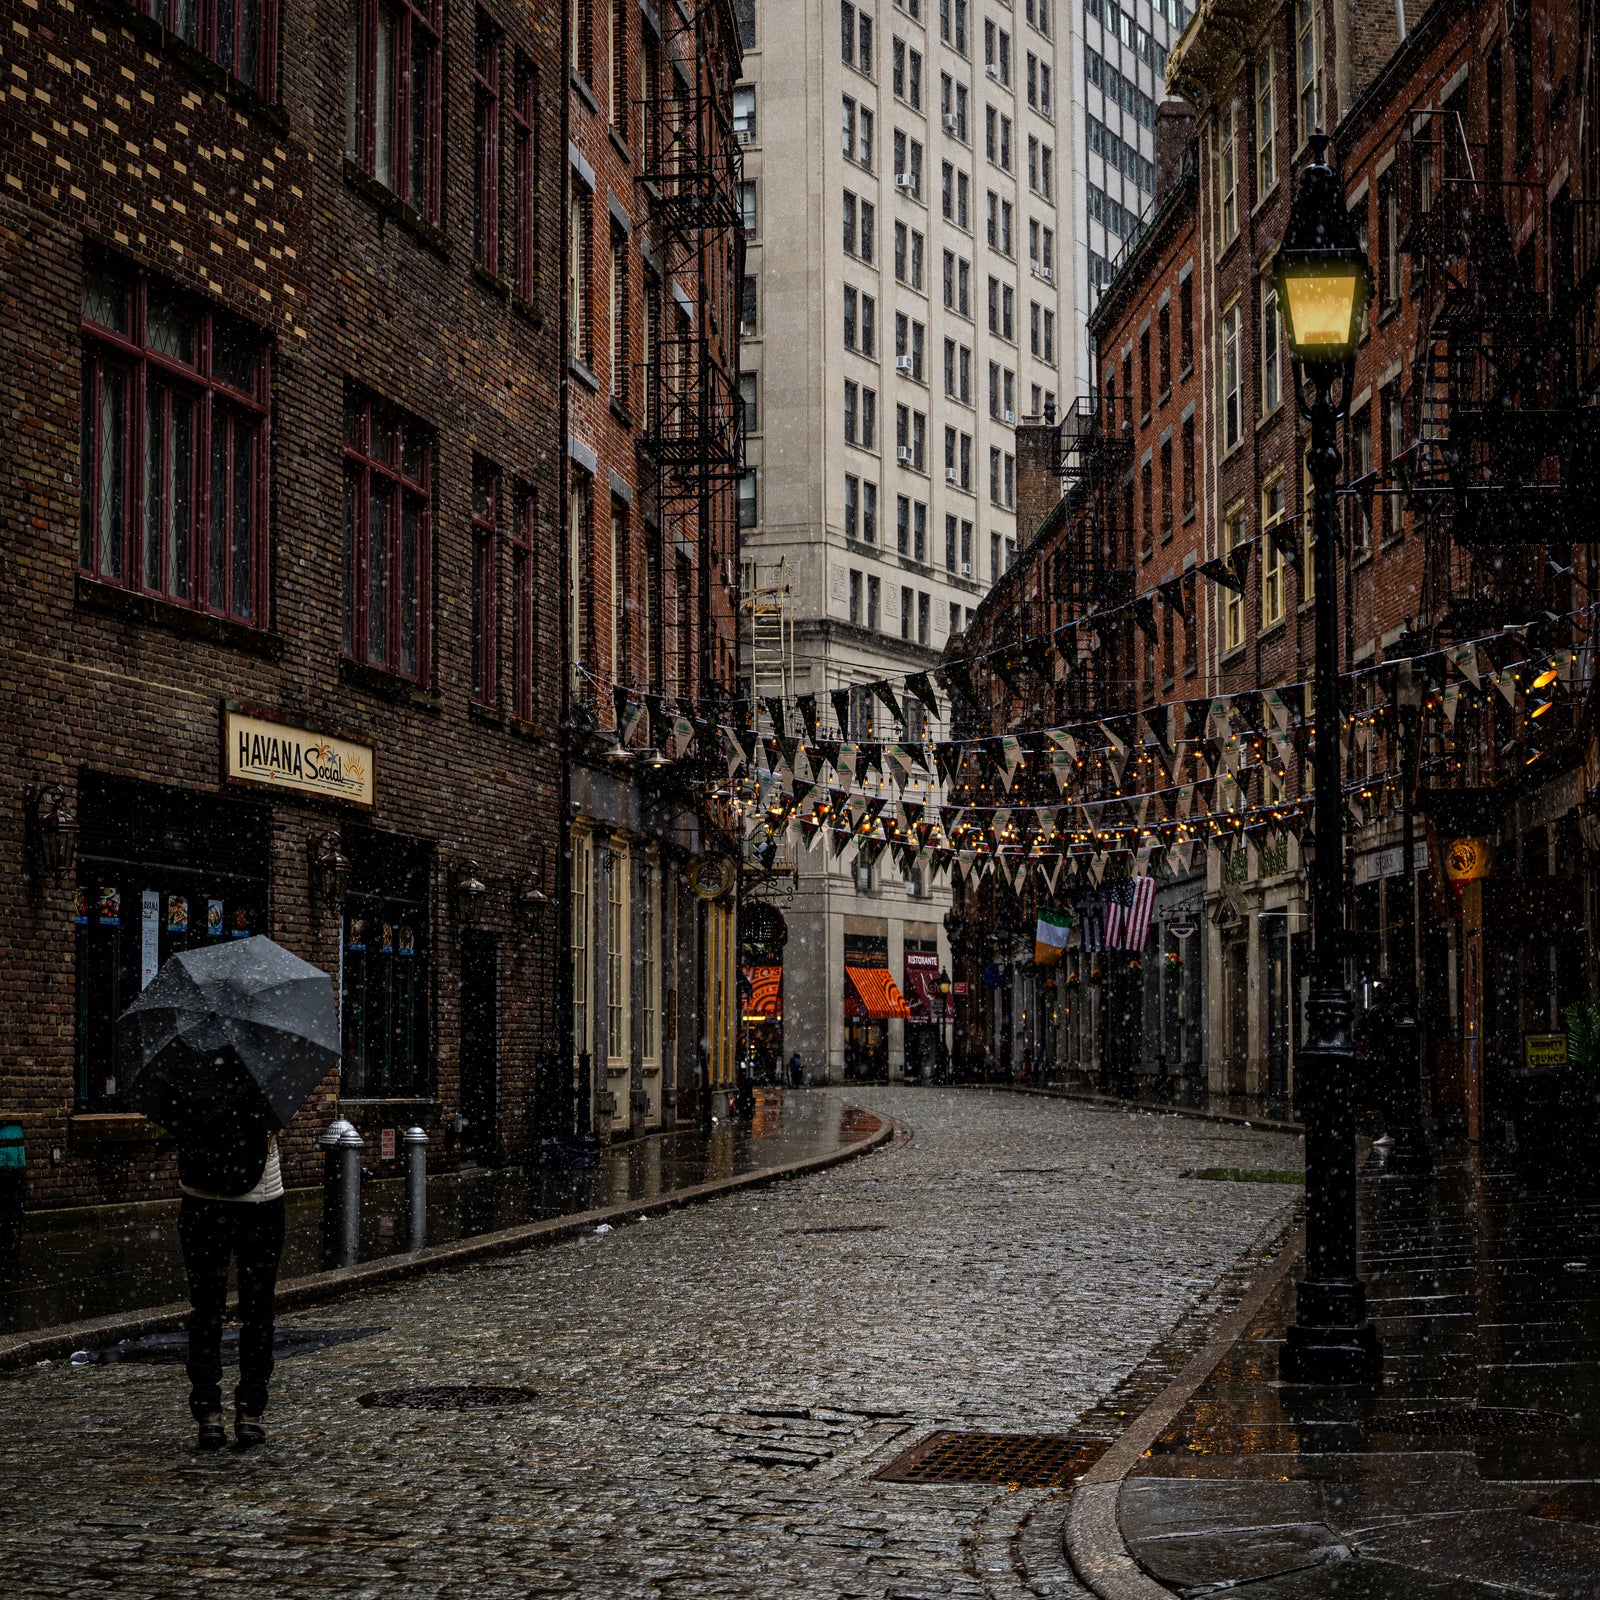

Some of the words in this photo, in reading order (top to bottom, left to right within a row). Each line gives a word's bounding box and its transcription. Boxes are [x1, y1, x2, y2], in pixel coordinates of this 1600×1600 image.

[239, 730, 303, 780] HAVANA
[304, 747, 343, 783] Social
[907, 955, 938, 966] RISTORANTE
